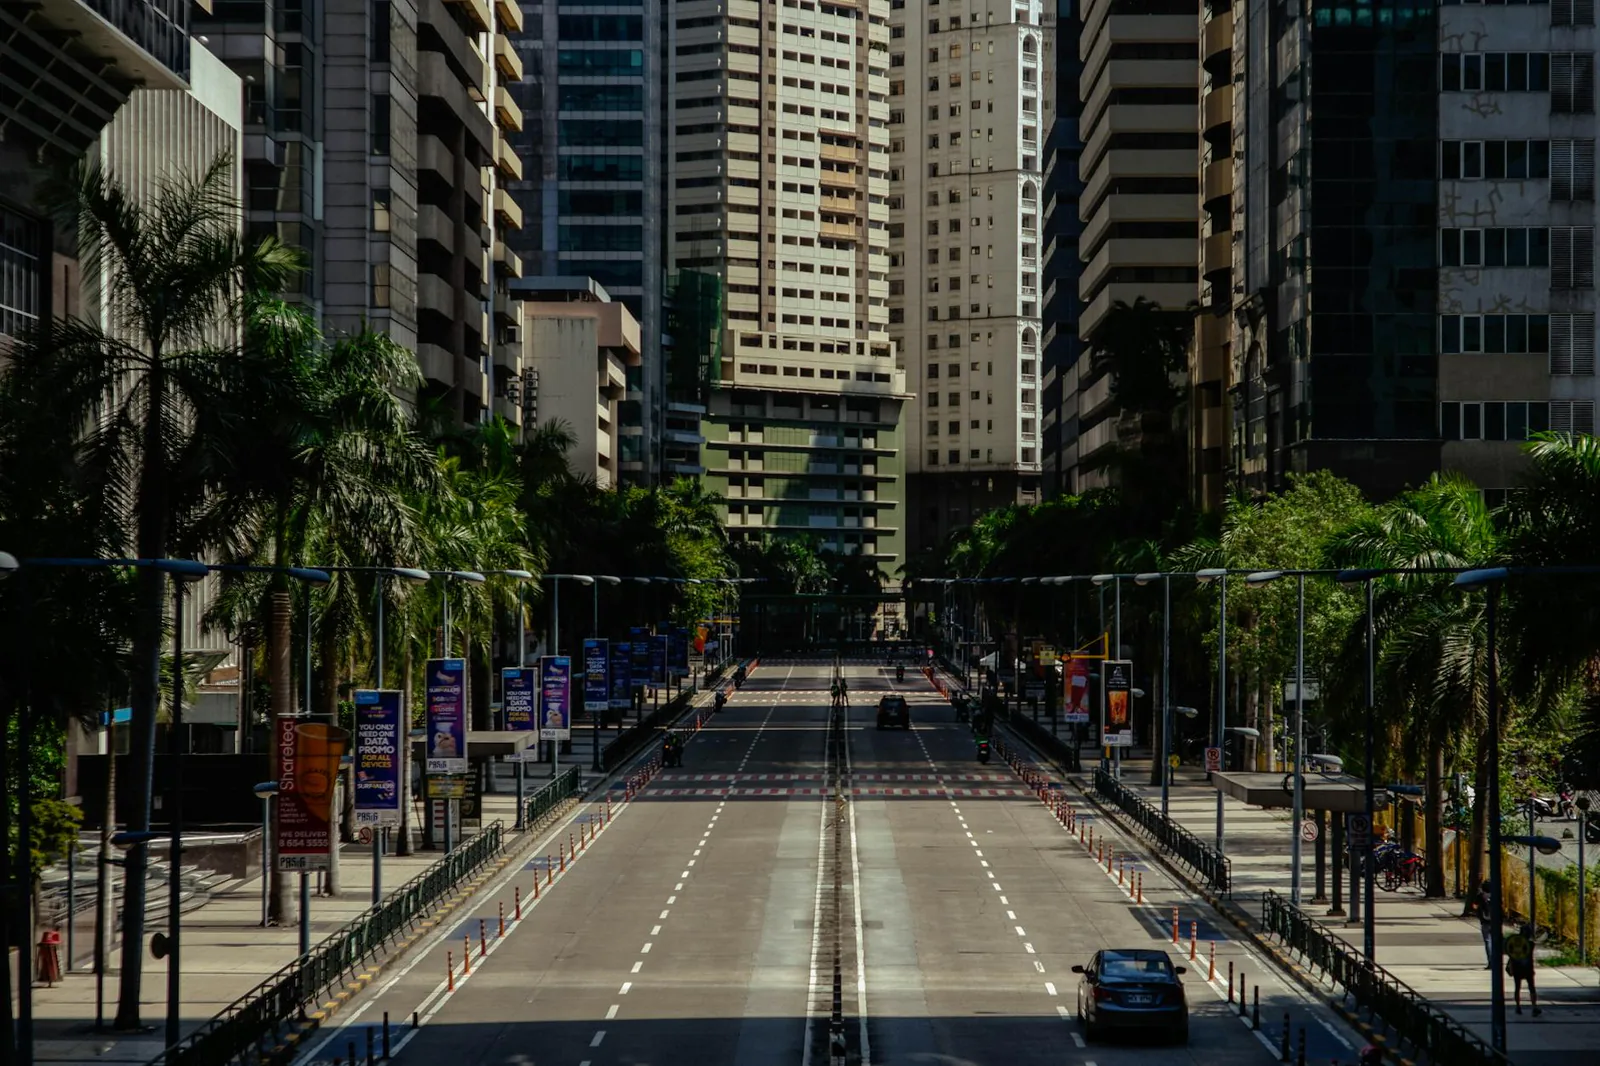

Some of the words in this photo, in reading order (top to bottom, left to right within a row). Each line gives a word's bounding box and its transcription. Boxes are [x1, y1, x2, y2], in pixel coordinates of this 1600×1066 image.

[358, 723, 375, 731] YOU
[376, 723, 395, 731] ONLY
[358, 730, 378, 738] NEED
[378, 730, 395, 738] ONE
[364, 737, 390, 746] DATA
[358, 745, 396, 755] PROMO
[279, 721, 294, 790] Sharetea
[294, 830, 328, 838] DELIVER
[279, 839, 286, 847] 8
